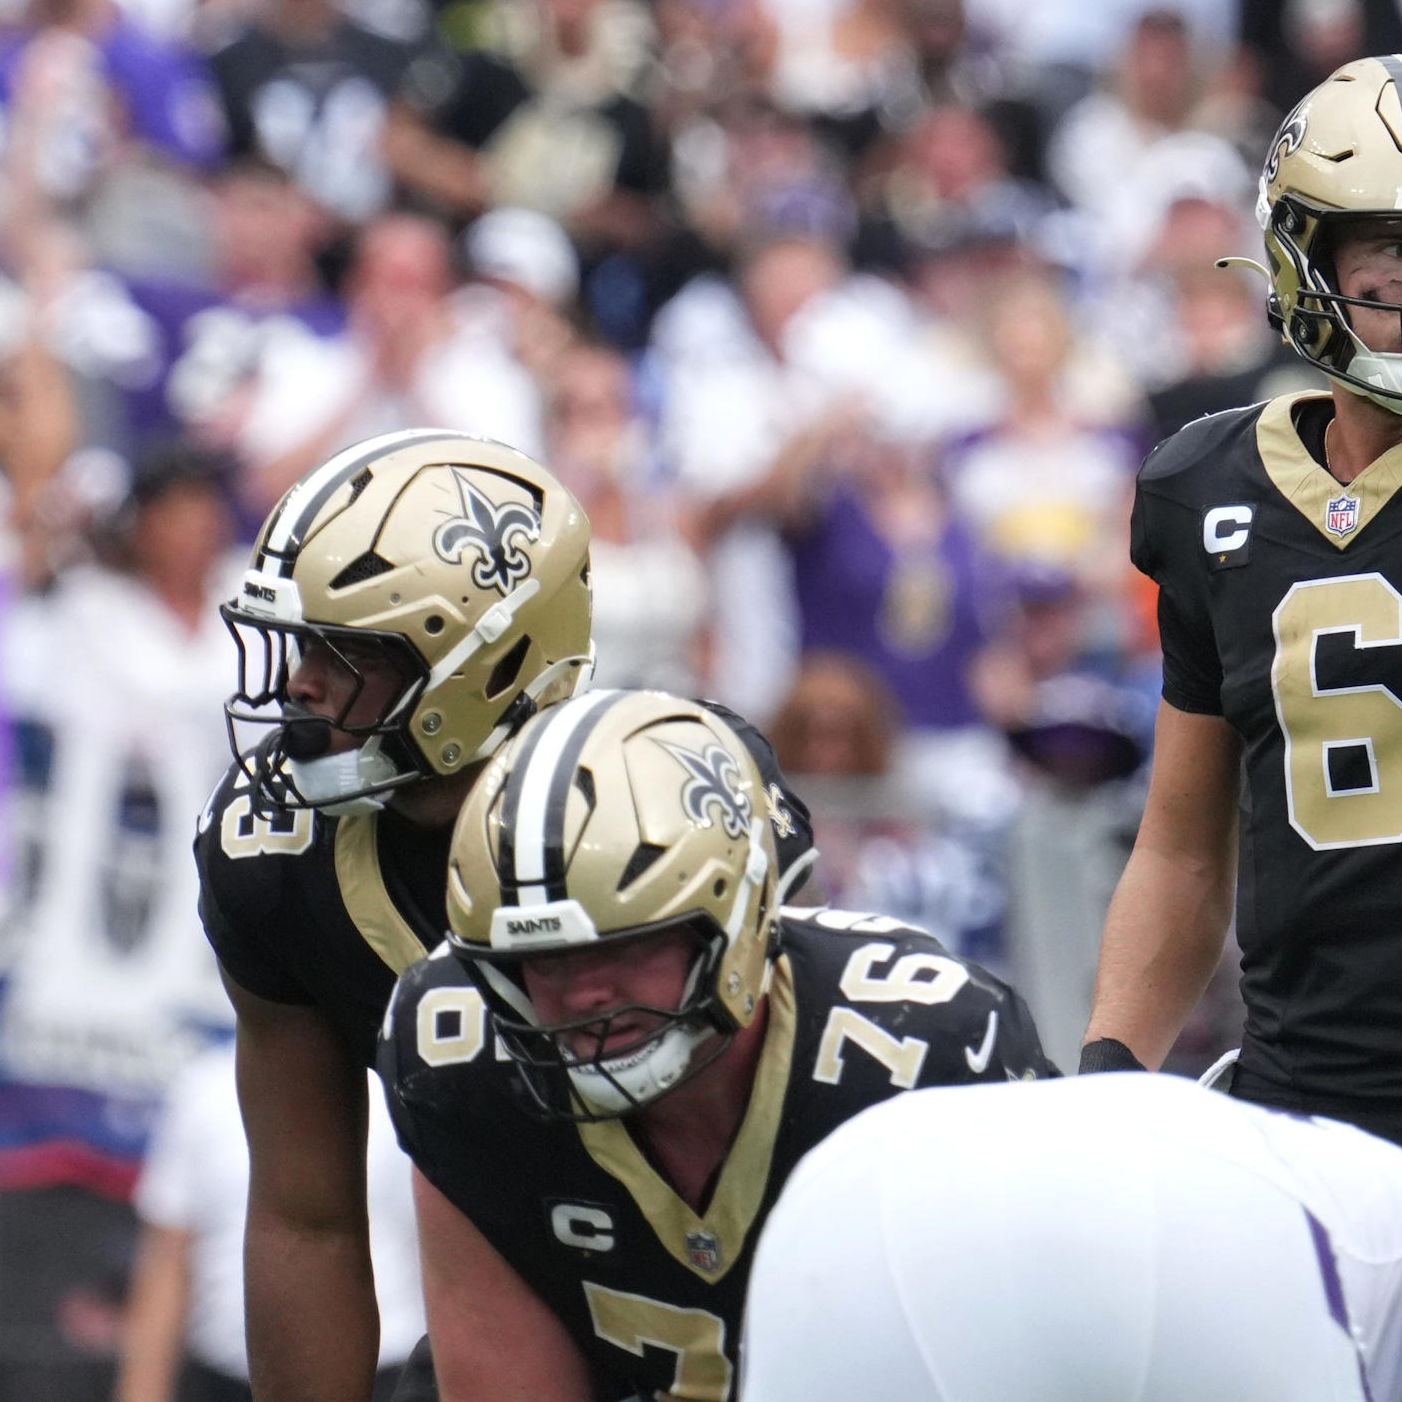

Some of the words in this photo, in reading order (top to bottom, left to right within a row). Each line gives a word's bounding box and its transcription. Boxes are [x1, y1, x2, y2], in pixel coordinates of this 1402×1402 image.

[1203, 506, 1252, 554] C
[1330, 512, 1353, 530] NFL
[507, 917, 561, 935] SAINTS
[812, 942, 969, 1089] 76
[551, 1204, 615, 1252] C
